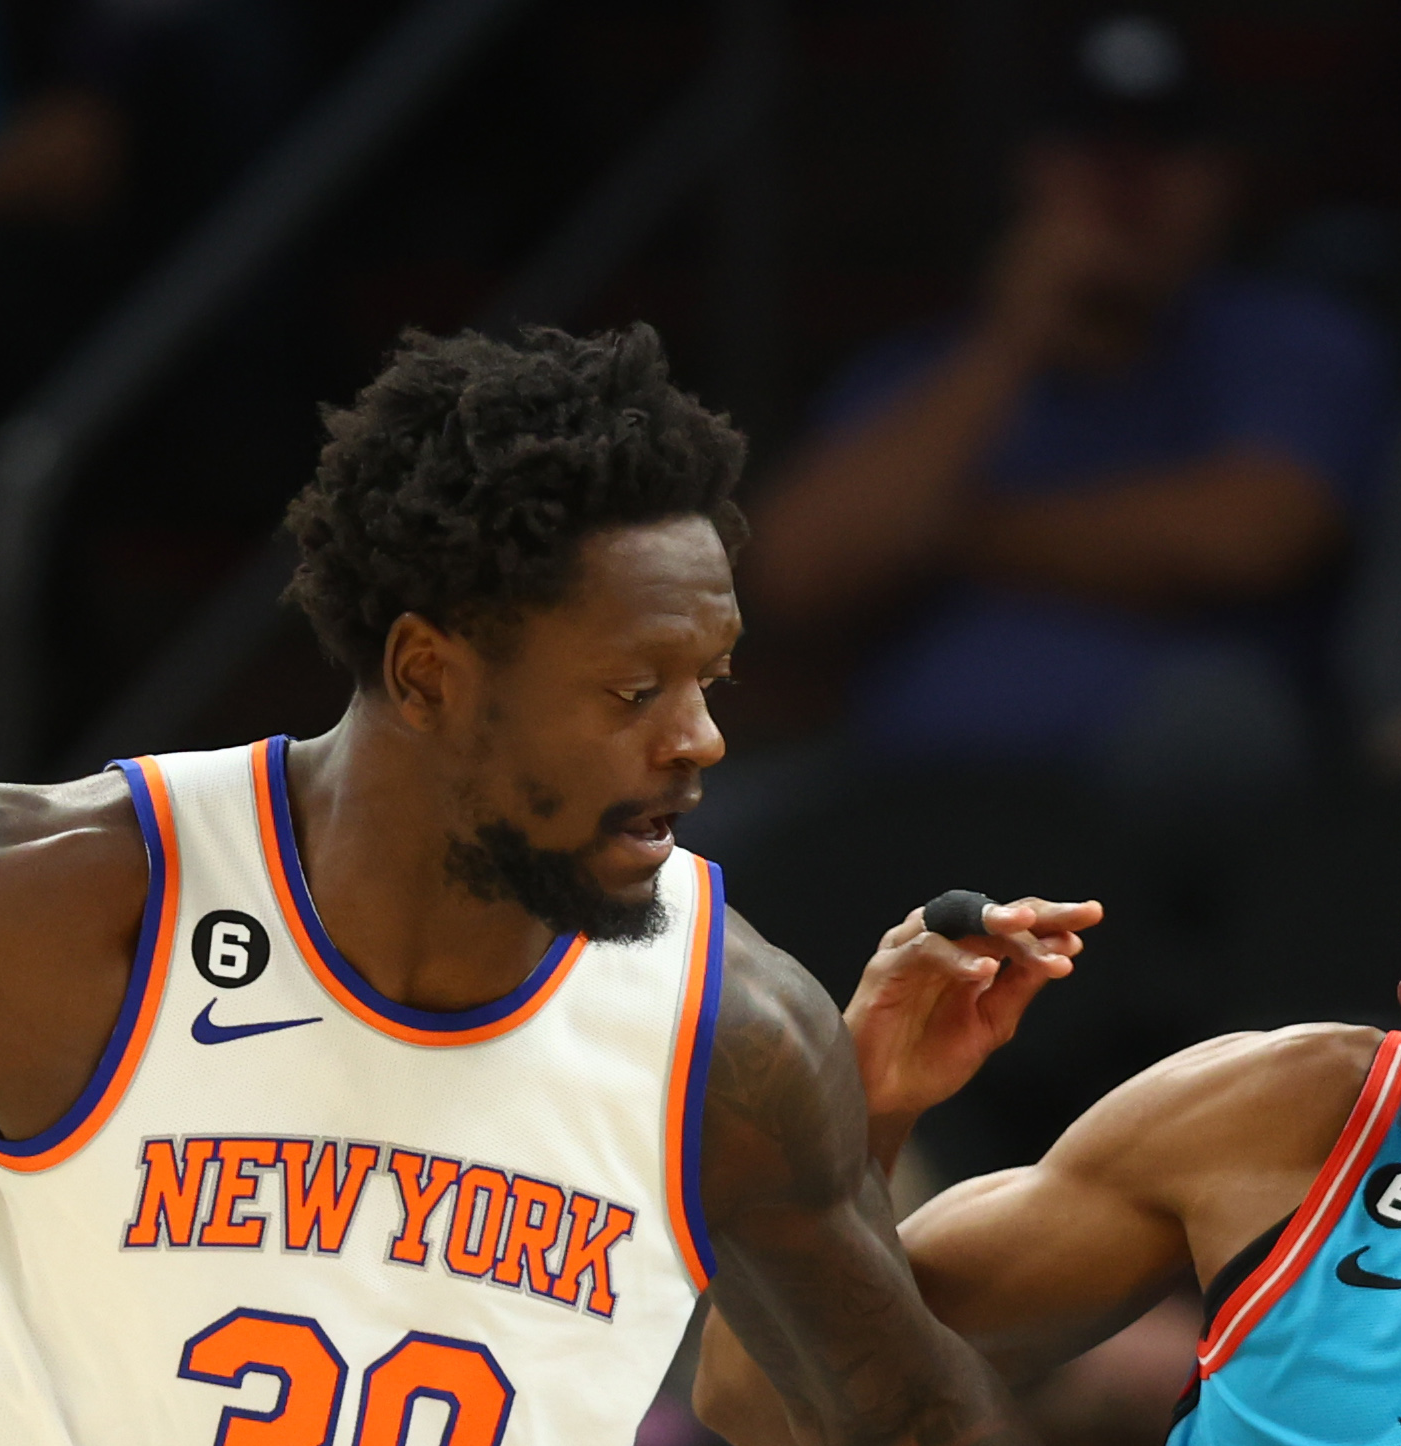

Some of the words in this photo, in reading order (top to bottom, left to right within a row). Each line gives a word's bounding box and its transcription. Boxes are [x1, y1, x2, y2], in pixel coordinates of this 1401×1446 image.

[207, 920, 251, 979] 6
[120, 1134, 382, 1253] NEW
[386, 1144, 637, 1321] YORK
